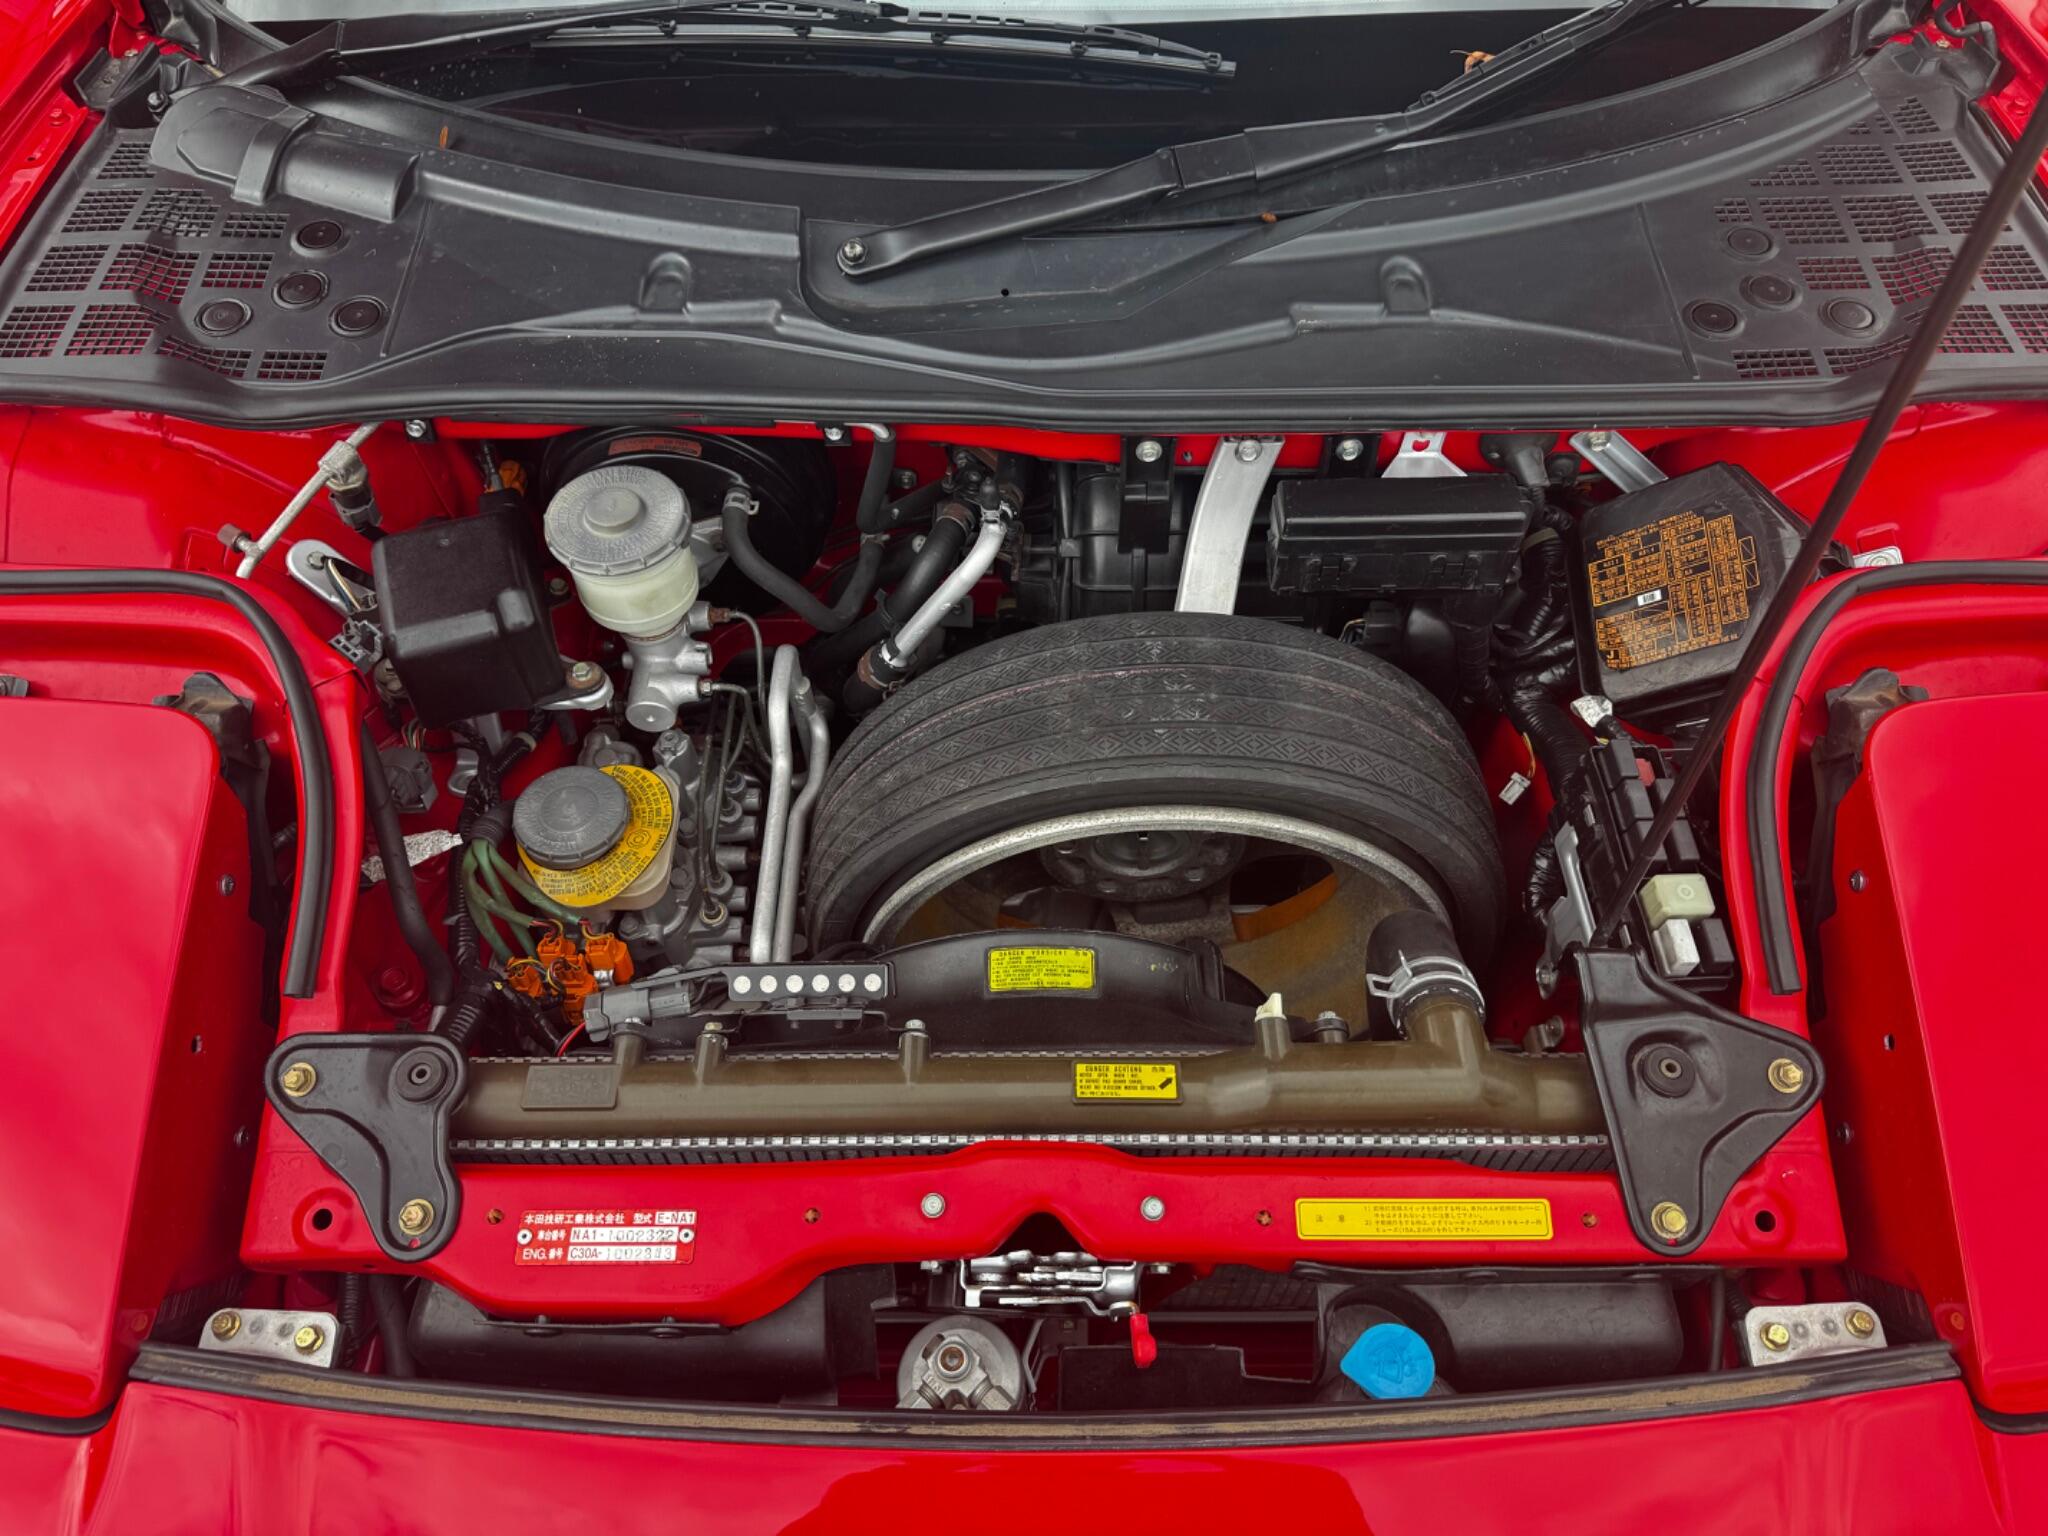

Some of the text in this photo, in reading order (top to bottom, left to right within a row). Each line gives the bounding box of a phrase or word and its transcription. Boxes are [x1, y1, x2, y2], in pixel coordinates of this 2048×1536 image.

[524, 1212, 625, 1225] 本田技研工業株式会社
[656, 1212, 694, 1224] E-NA1
